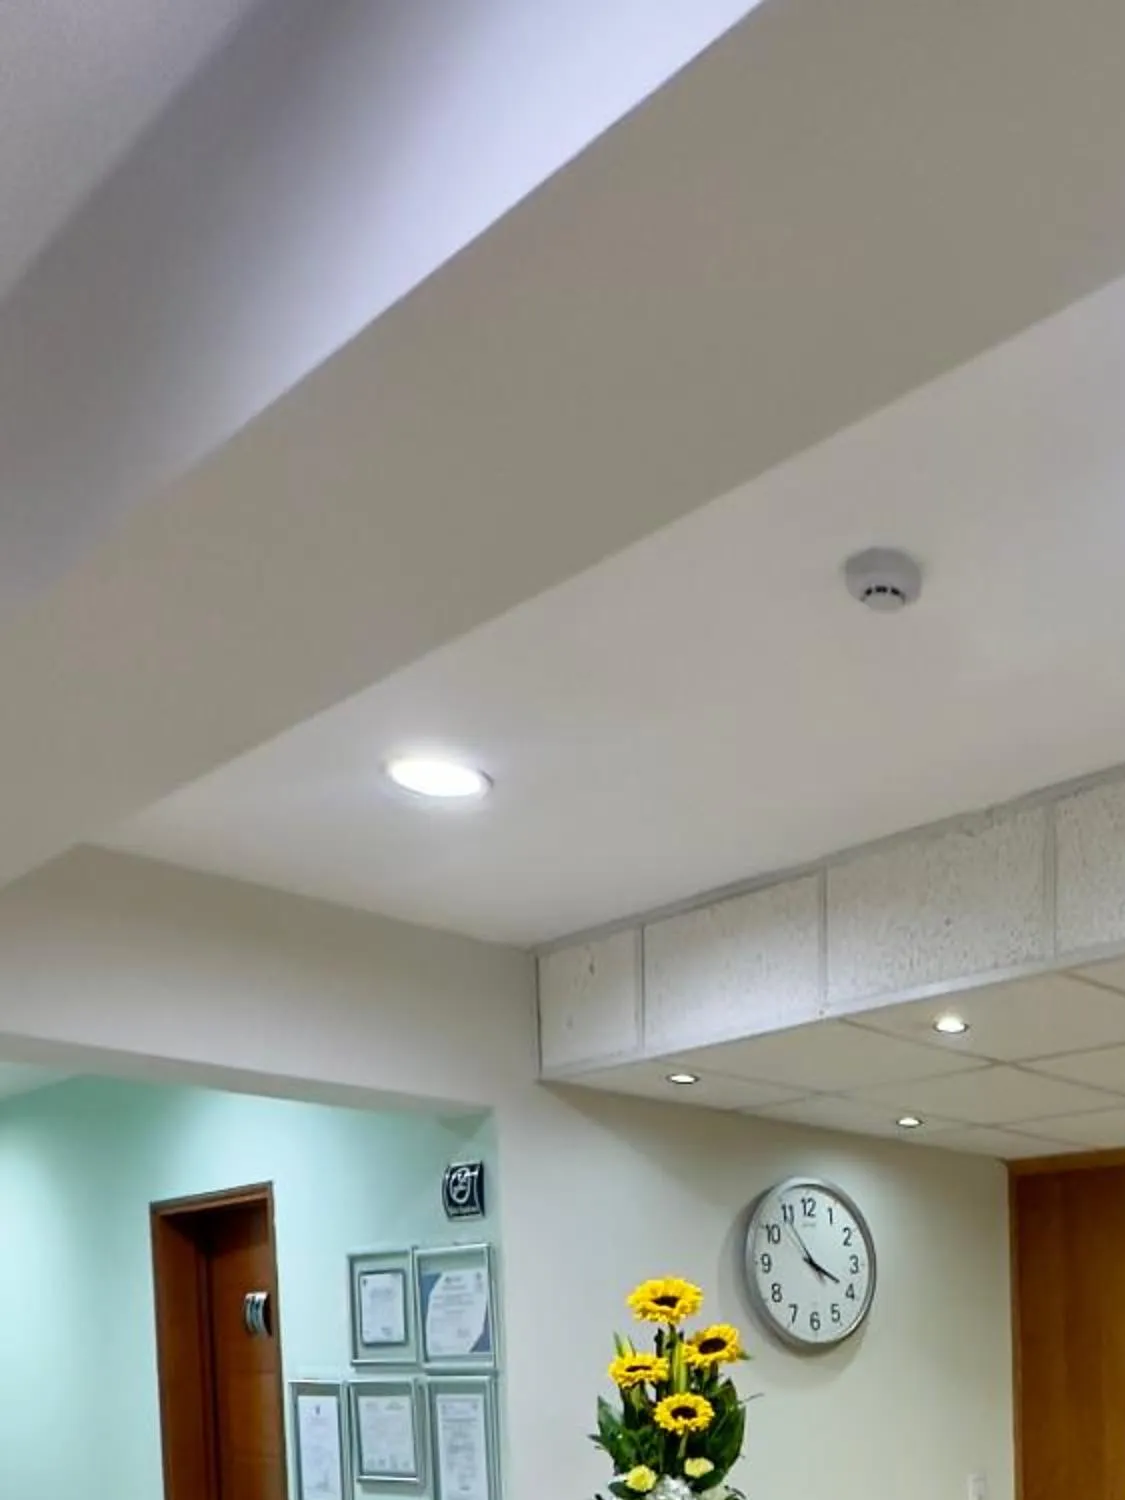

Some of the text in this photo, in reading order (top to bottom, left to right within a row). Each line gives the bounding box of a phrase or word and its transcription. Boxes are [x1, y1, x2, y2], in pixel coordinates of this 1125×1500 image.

[782, 1205, 794, 1225] 11
[801, 1198, 816, 1217] 12
[827, 1208, 834, 1226] 1
[765, 1224, 781, 1244] 10
[843, 1227, 852, 1247] 2
[760, 1254, 772, 1274] 9
[849, 1255, 859, 1274] 3
[772, 1283, 782, 1303] 8
[845, 1283, 855, 1300] 4
[788, 1304, 798, 1324] 7
[810, 1312, 820, 1331] 6
[830, 1303, 841, 1322] 5
